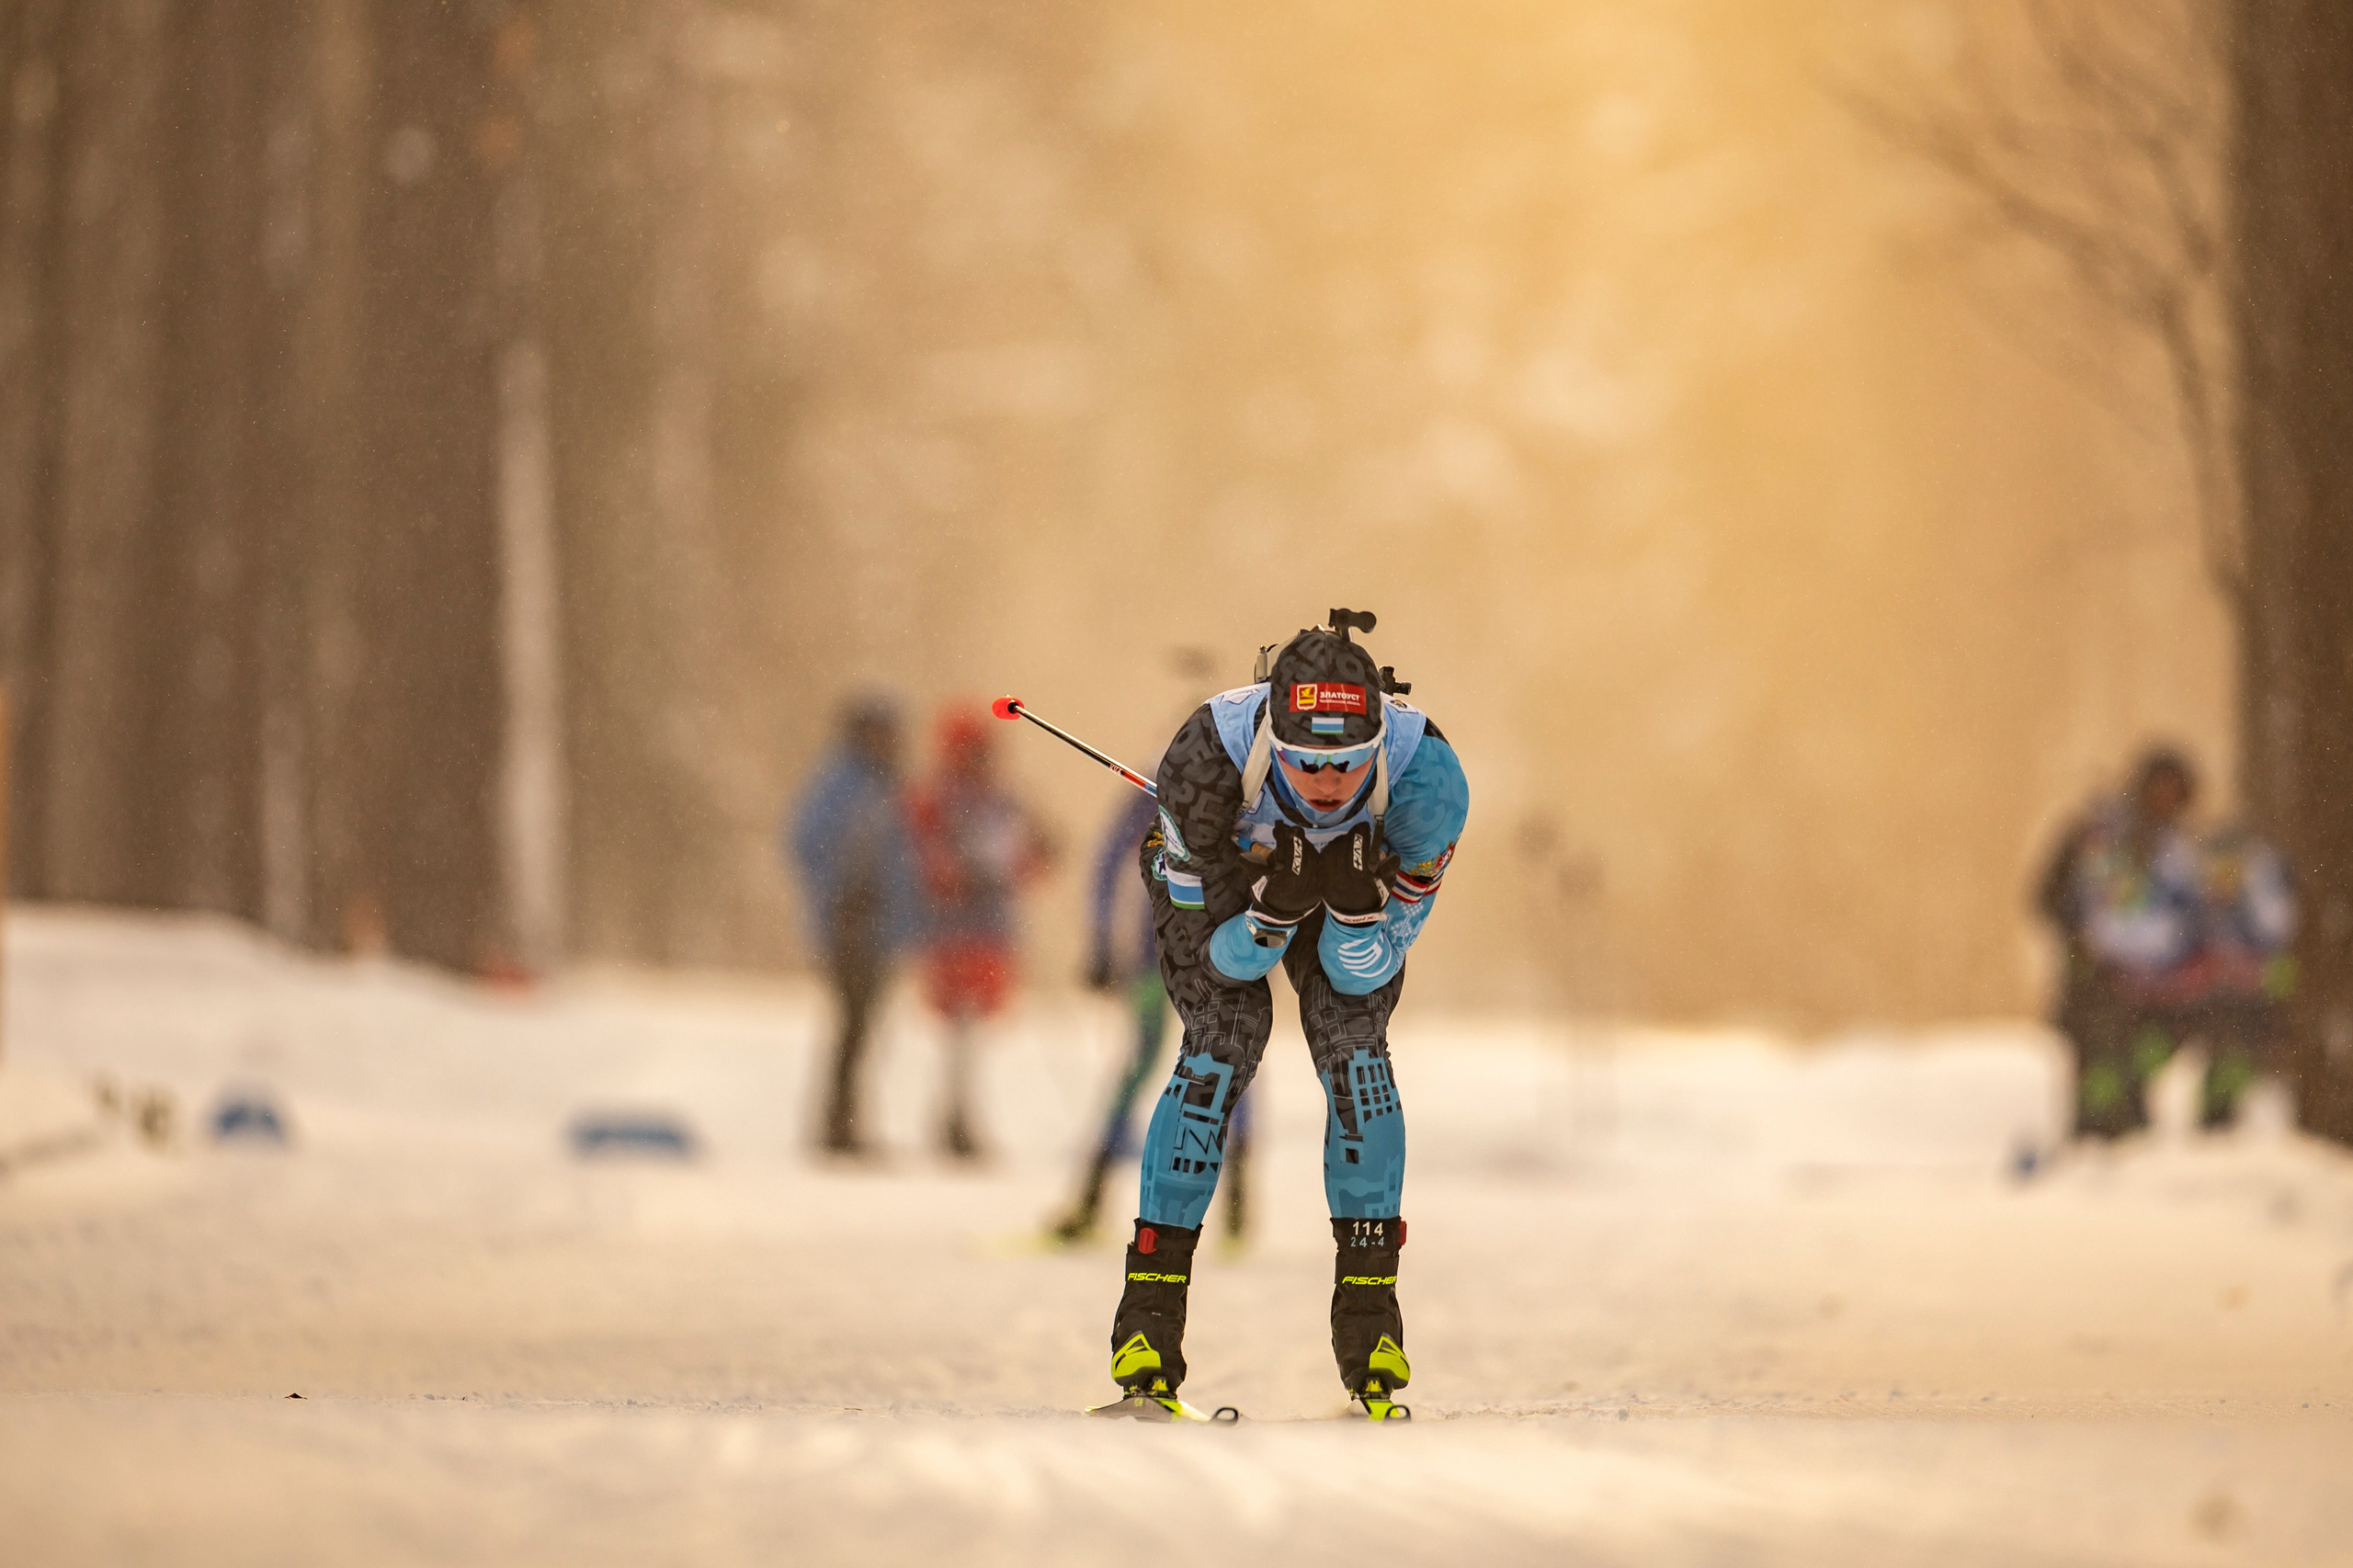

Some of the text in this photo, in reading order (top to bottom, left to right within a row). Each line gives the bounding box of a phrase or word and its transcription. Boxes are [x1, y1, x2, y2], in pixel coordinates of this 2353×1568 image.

[1319, 691, 1360, 701] ЗЛАТОУСТ
[1352, 1221, 1384, 1236] 114
[1127, 1272, 1188, 1284] FISCHER
